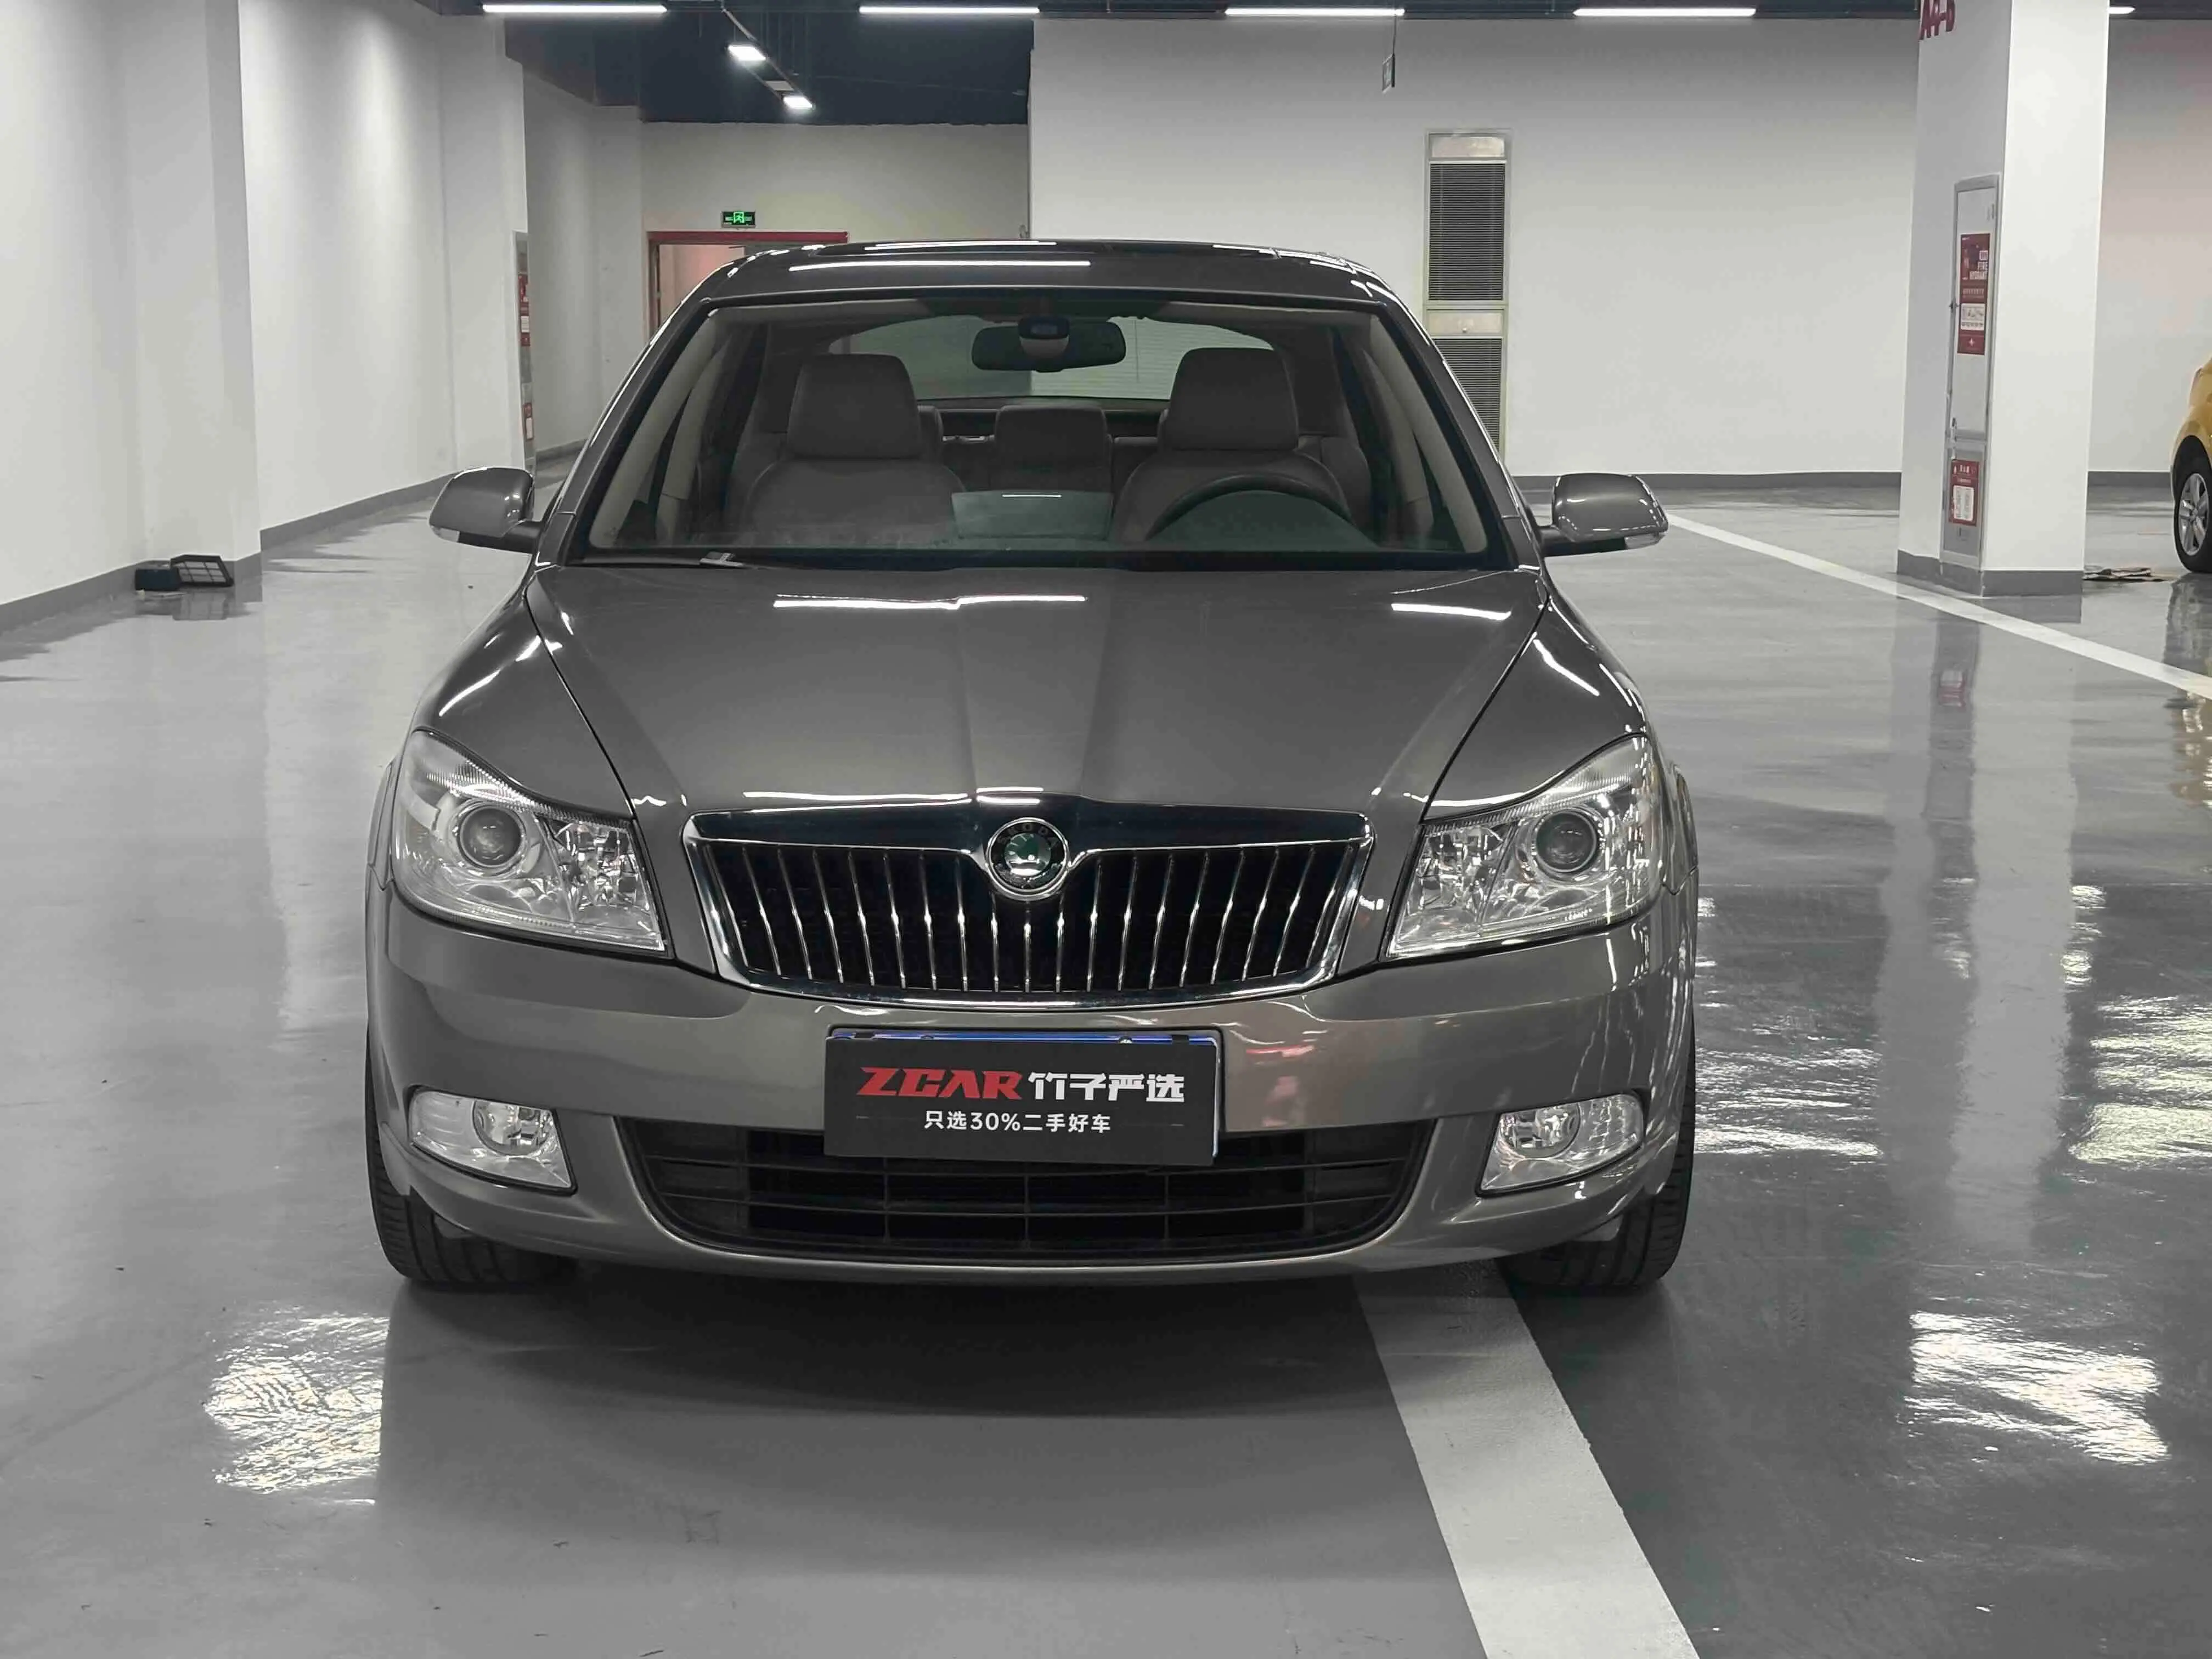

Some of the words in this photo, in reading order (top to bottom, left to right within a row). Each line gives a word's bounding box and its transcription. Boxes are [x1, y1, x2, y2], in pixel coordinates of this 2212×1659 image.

[1028, 1071, 1185, 1103] 竹子严选
[924, 1110, 1111, 1133] 只选30%二手好车
